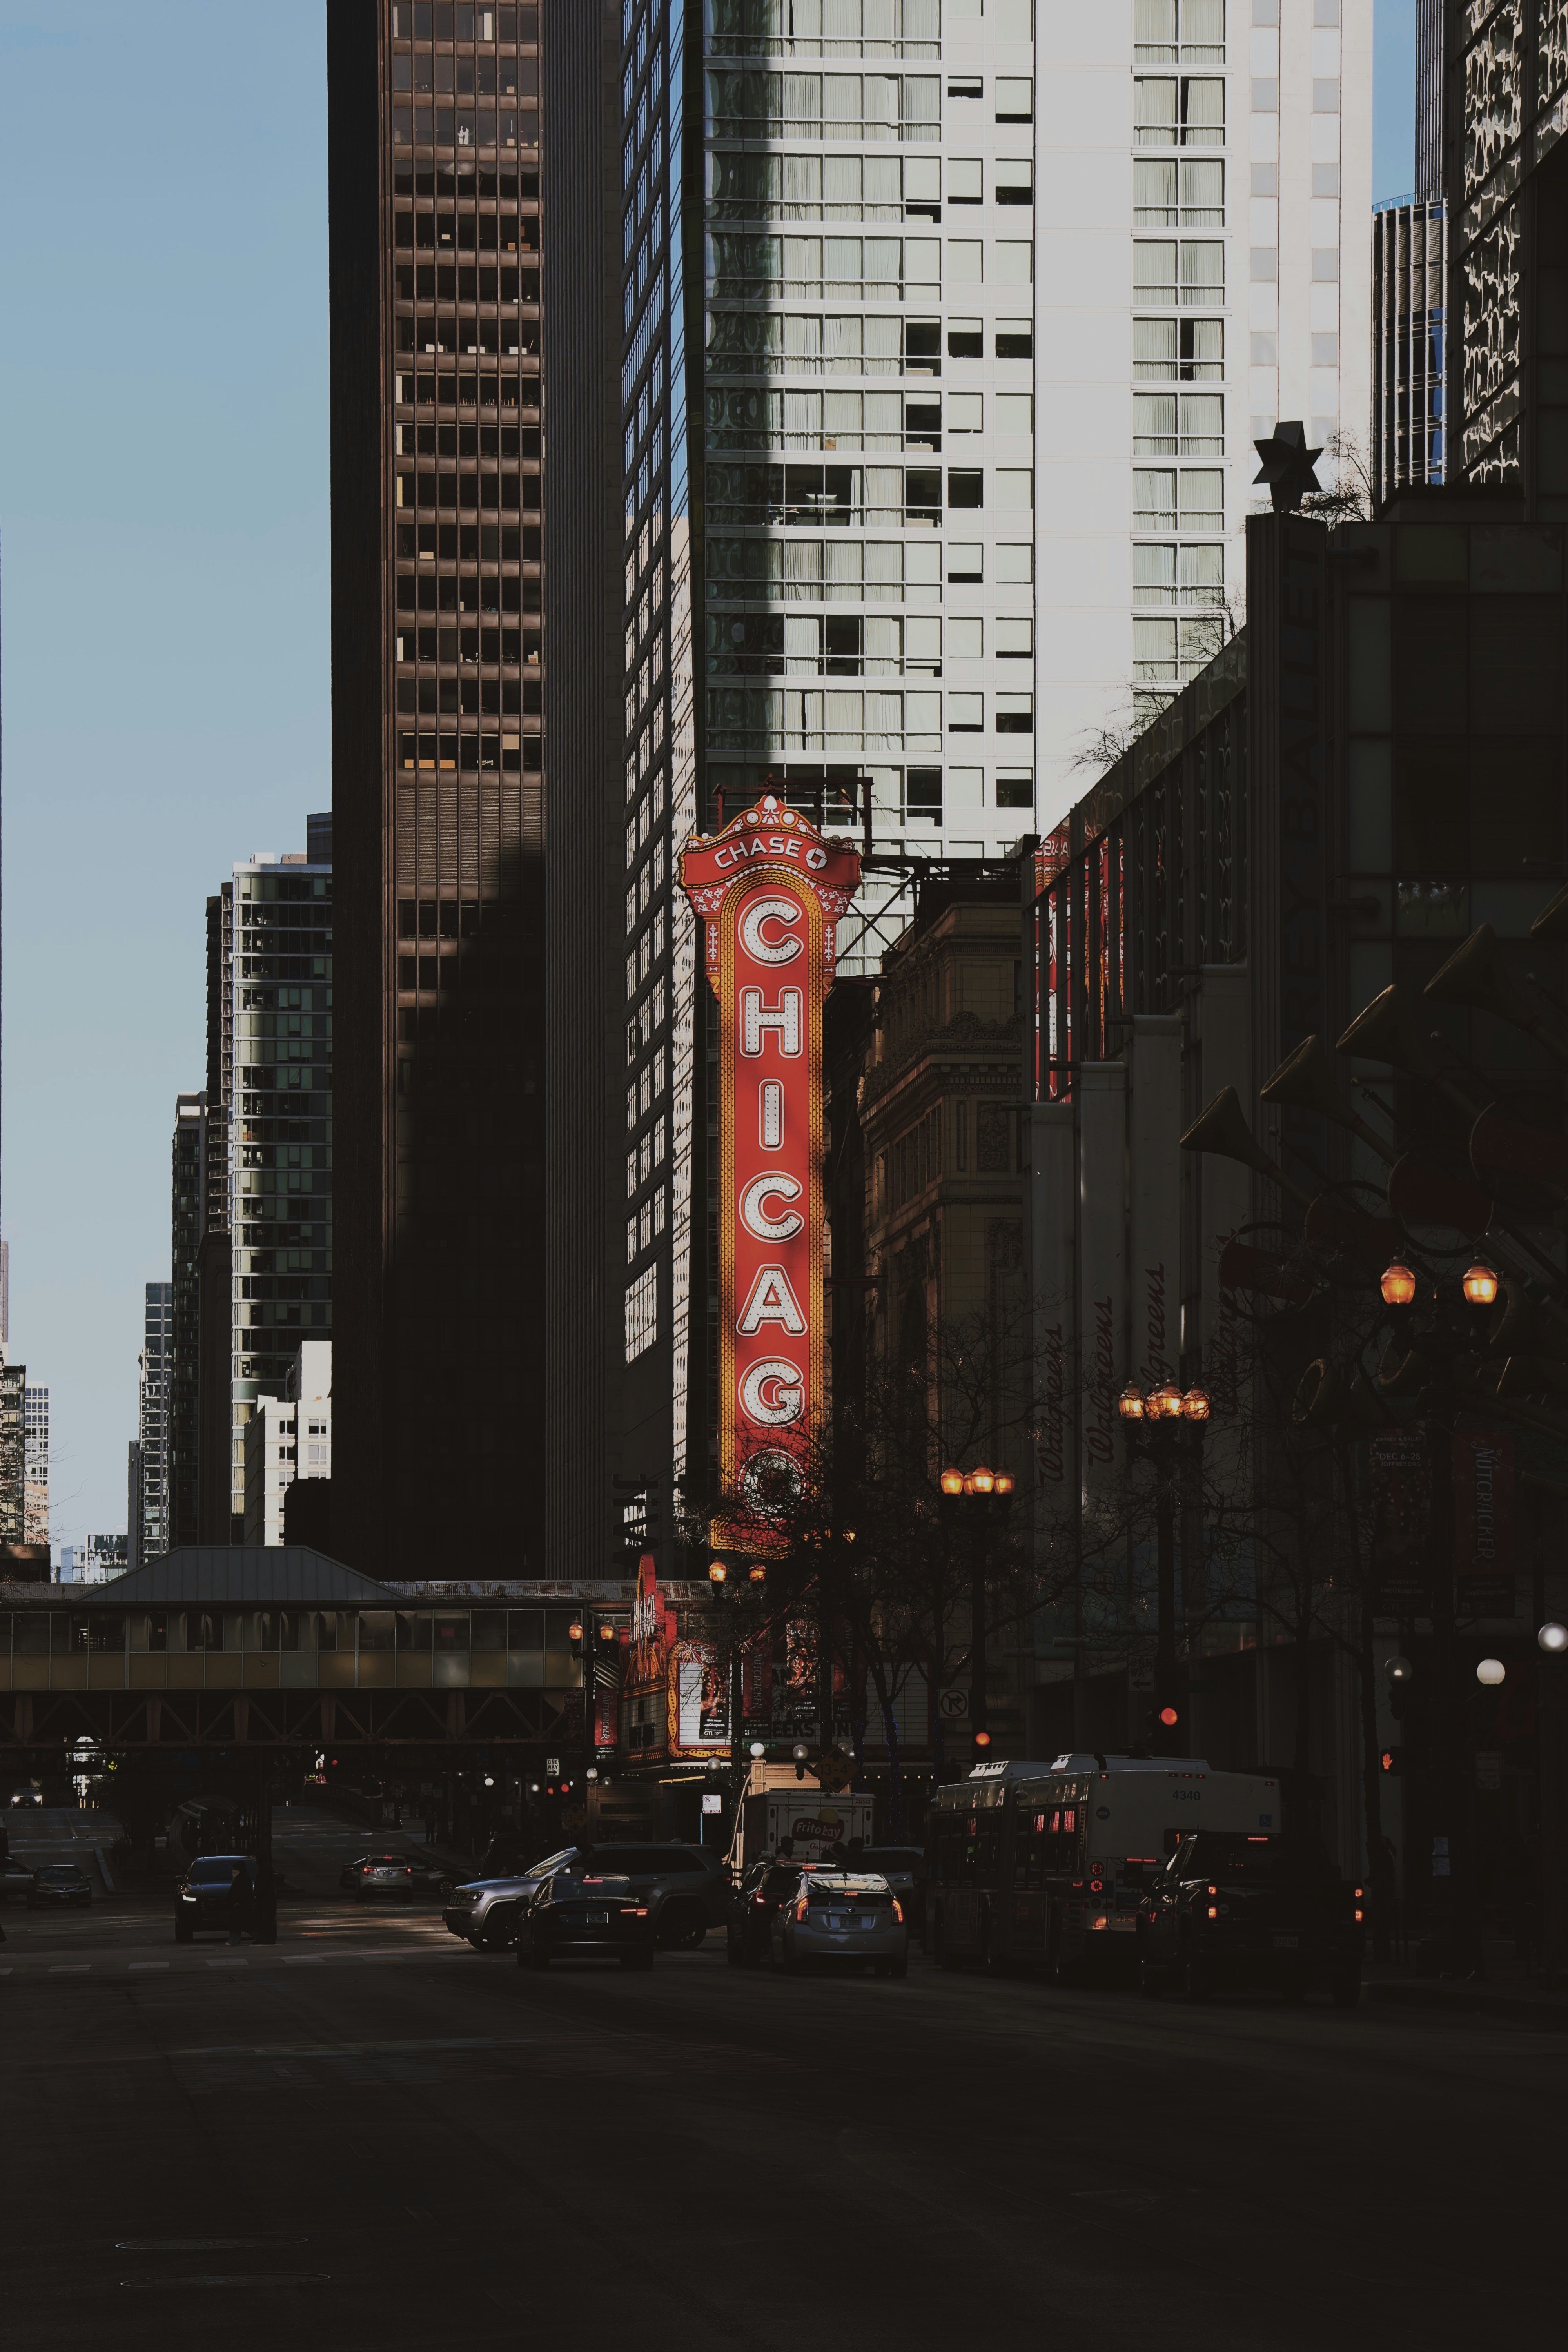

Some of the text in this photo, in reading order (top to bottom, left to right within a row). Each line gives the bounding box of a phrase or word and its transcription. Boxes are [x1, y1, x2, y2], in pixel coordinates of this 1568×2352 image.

[714, 837, 803, 869] CHASE
[737, 895, 807, 1520] CHICAGO
[1085, 1296, 1121, 1467] Walgreens
[1140, 1261, 1176, 1394] lgreens
[1037, 1323, 1073, 1485] Walgreens
[1471, 1441, 1497, 1565] NUTCRACKER
[796, 1822, 840, 1839] Frito Lay
[809, 1842, 827, 1851] Good
[1172, 1790, 1200, 1800] 4340
